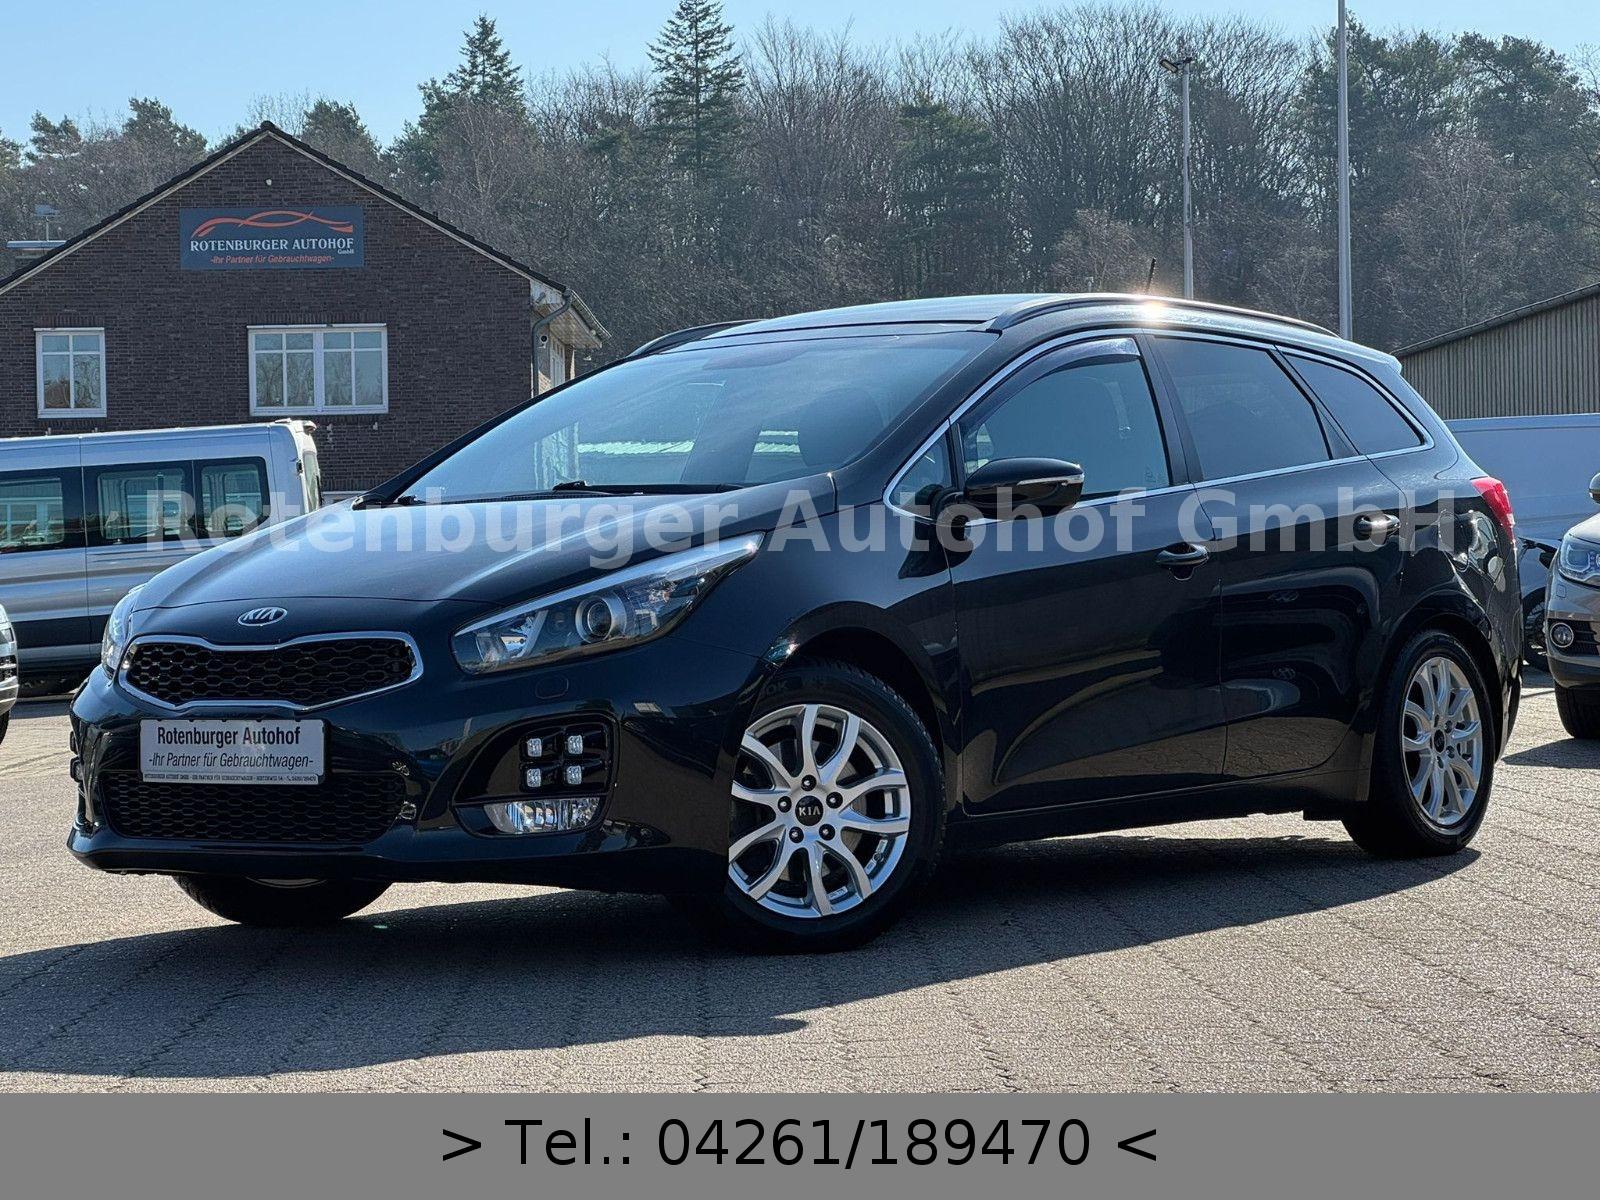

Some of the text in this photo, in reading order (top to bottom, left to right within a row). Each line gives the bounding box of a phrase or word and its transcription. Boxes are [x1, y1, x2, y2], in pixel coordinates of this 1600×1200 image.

[190, 238, 355, 252] ROTENBURGER AUTOHOF
[226, 255, 254, 264] Partner
[255, 255, 265, 263] für
[157, 727, 301, 748] Rotenburger Autohof
[166, 753, 201, 768] Partner
[203, 752, 217, 767] für
[219, 753, 313, 770] Gebrauchtwagen-
[798, 805, 821, 817] KIA
